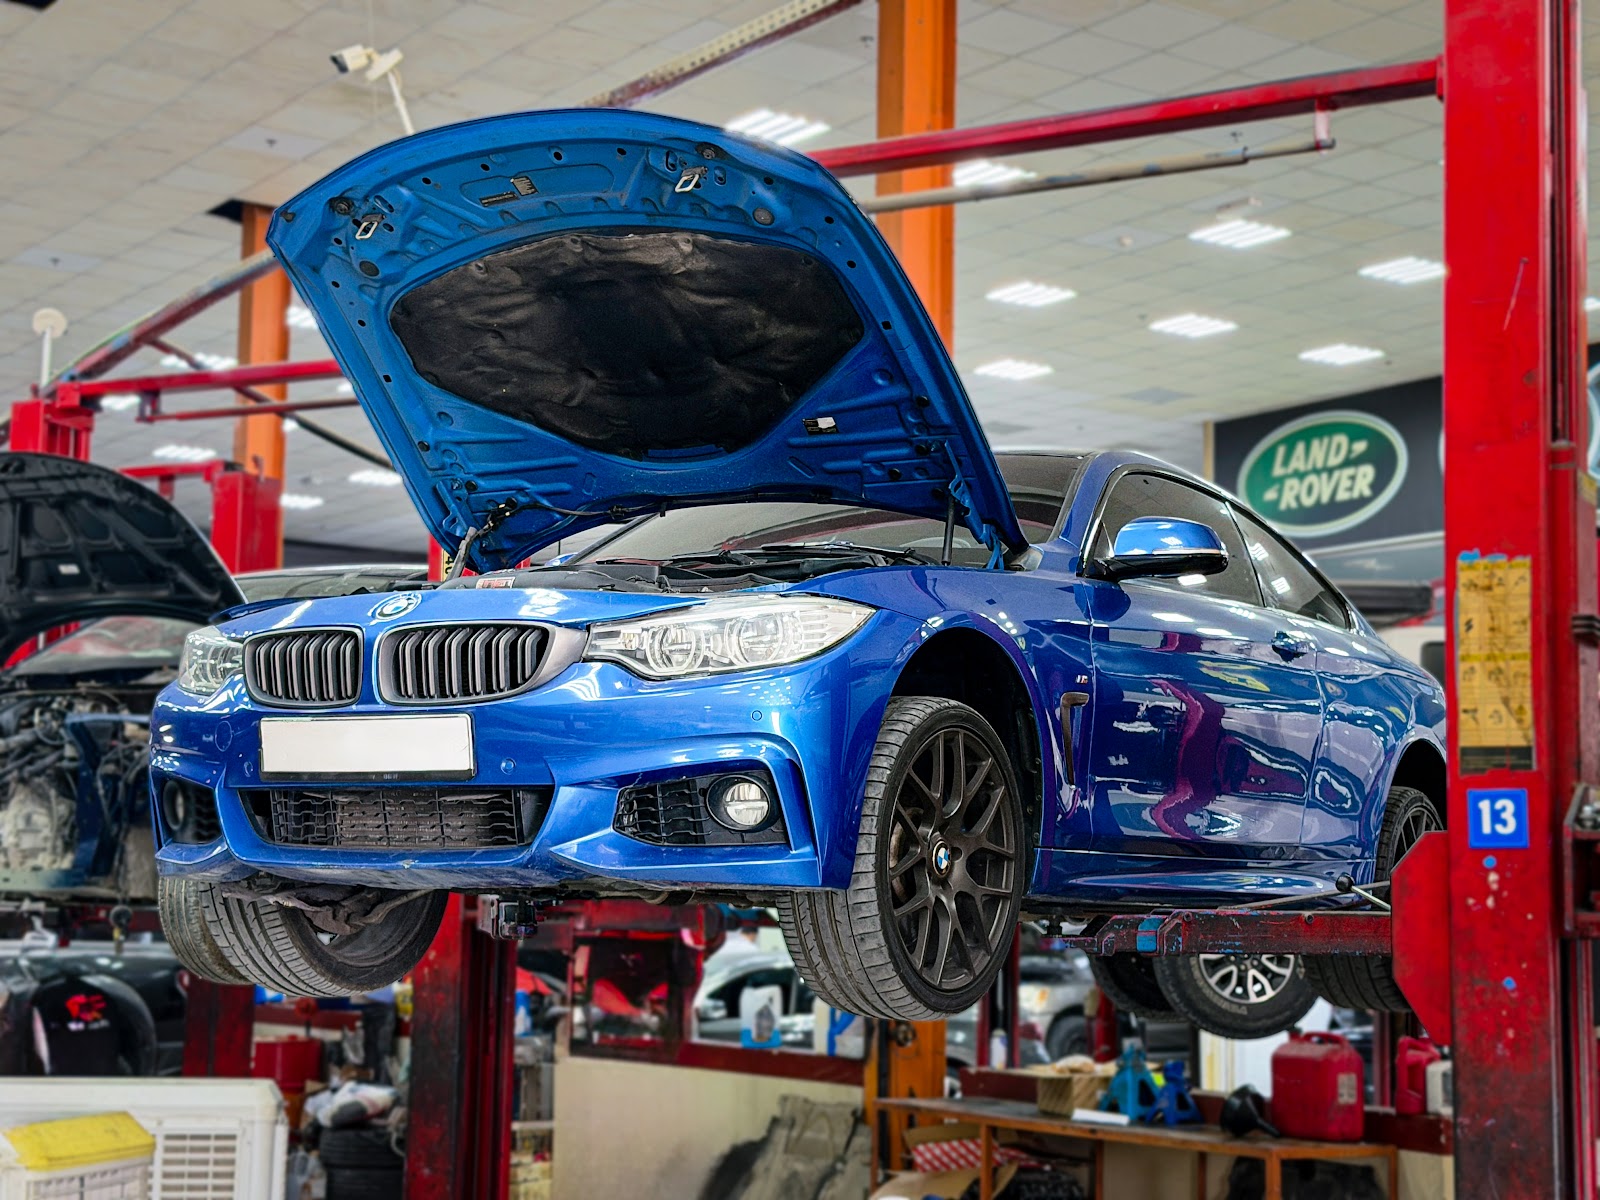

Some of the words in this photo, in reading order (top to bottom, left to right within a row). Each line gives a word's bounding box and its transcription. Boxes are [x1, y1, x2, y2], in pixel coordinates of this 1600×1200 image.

[1271, 433, 1349, 477] LAND
[1279, 464, 1376, 511] ROVER
[1478, 799, 1517, 835] 13
